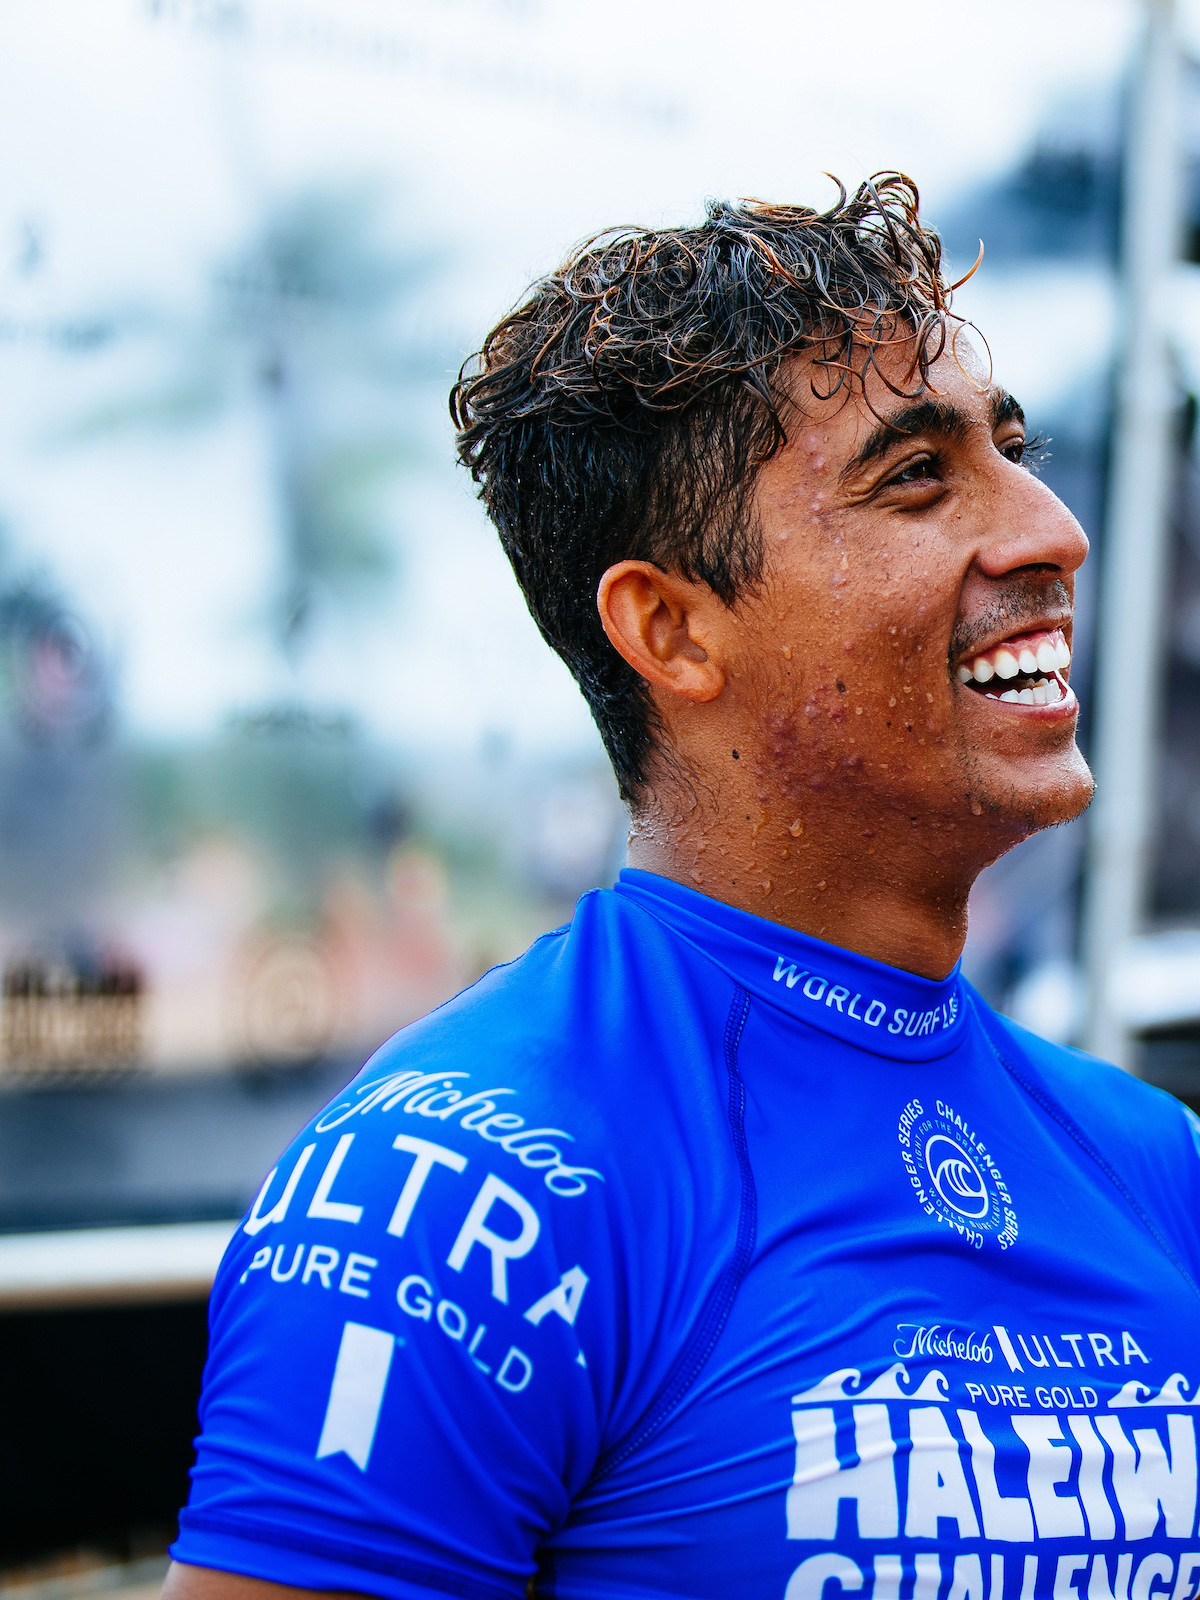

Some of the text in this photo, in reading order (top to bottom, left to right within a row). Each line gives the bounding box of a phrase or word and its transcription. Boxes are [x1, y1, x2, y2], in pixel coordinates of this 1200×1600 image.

[772, 956, 887, 1027] WORLD
[887, 1006, 941, 1037] SURF
[315, 1070, 605, 1197] Michelob
[898, 1098, 984, 1250] CHALLENGER SERIES
[914, 1119, 986, 1173] FIGHT FOR THE DREAM
[935, 1099, 1019, 1250] CHALLENGER SERIES
[243, 1132, 590, 1368] ULTRA
[928, 1187, 966, 1224] WORLD
[240, 1243, 533, 1392] PURE GOLD
[893, 1323, 1149, 1368] Michelob ULTRA
[964, 1382, 1099, 1409] PURE GOLD
